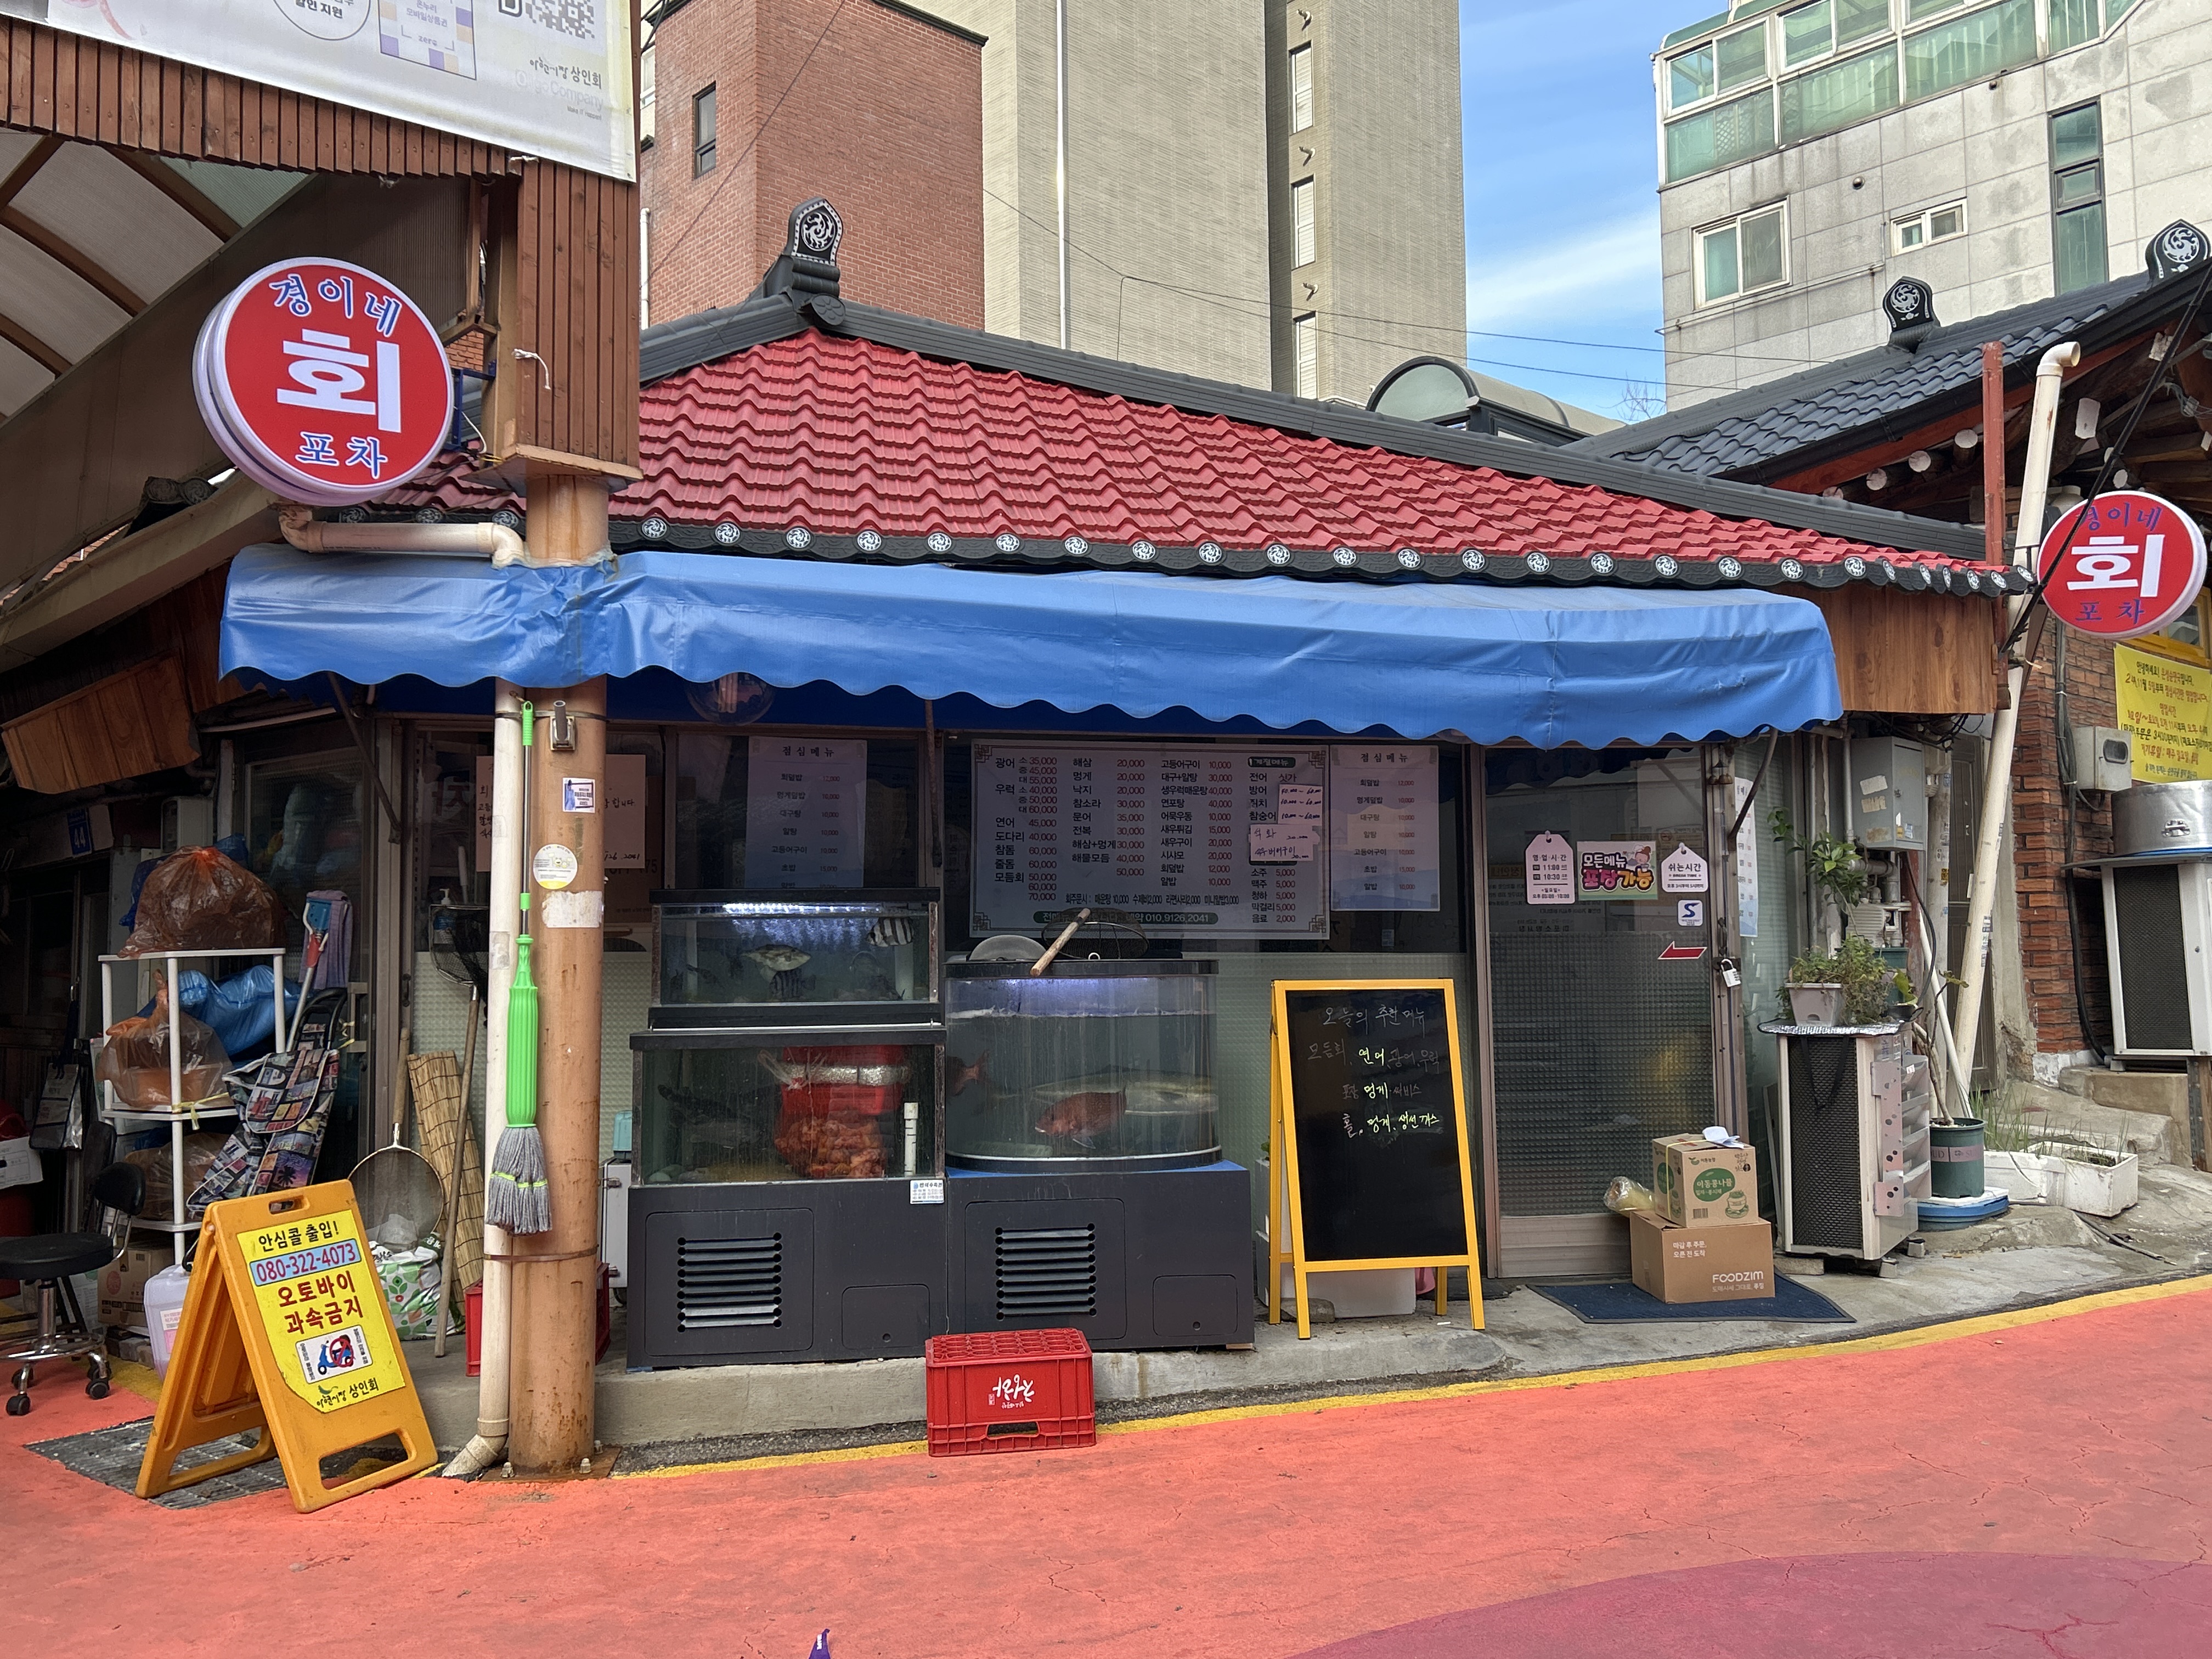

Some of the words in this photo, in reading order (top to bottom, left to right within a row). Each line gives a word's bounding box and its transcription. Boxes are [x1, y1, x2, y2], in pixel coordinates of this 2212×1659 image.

[320, 3, 343, 19] 지원
[417, 0, 437, 13] 온누리
[407, 8, 448, 27] 모바일상품권
[418, 35, 437, 46] zero
[571, 66, 601, 89] 상인회
[269, 274, 402, 337] 경이네
[276, 328, 402, 433] 회
[295, 431, 388, 478] 포차
[2076, 502, 2162, 531] 경이네
[2067, 534, 2165, 598] 회
[2075, 599, 2145, 625] 포차
[995, 758, 1015, 768] 광어
[1029, 757, 1057, 766] 35,000
[1073, 758, 1092, 767] 해삼
[1117, 759, 1146, 768] 20,000
[1161, 760, 1200, 769] 고등어구이
[1209, 761, 1232, 769] 10,000
[1029, 767, 1057, 775] 45,000
[1029, 777, 1057, 785] 55,000
[1073, 771, 1092, 781] 멍게
[1117, 772, 1146, 782] 20,000
[1161, 772, 1197, 782] 대구+알탕
[1209, 774, 1232, 782] 30,000
[1249, 773, 1267, 782] 전어
[1279, 774, 1297, 782] 싯가
[995, 784, 1015, 794] 우럭
[1029, 787, 1057, 795] 40,000
[1073, 785, 1092, 794] 낙지
[1117, 786, 1146, 795] 20,000
[1161, 785, 1207, 795] 생우럭매운탕
[1209, 787, 1232, 795] 40,000
[1249, 786, 1267, 795] 방어
[1029, 796, 1057, 805] 50,000
[1073, 799, 1101, 808] 참소라
[1117, 800, 1145, 809] 30,000
[1161, 798, 1185, 808] 연포탕
[1209, 799, 1232, 808] 40,000
[1029, 806, 1057, 815] 60,000
[1073, 812, 1091, 822] 문어
[1116, 814, 1144, 822] 35,000
[1161, 812, 1192, 822] 어묵우동
[1209, 812, 1231, 821] 10,000
[1249, 812, 1277, 821] 참숭어
[996, 817, 1015, 828] 연어
[1029, 819, 1057, 828] 45,000
[1073, 826, 1092, 836] 전복
[1116, 827, 1144, 836] 30,000
[1161, 825, 1193, 834] 새우튀김
[1209, 826, 1231, 834] 15,000
[74, 826, 86, 848] 44
[995, 831, 1025, 842] 도다리
[1029, 833, 1057, 842] 40,000
[1363, 831, 1376, 839] 알탕
[1072, 839, 1116, 849] 해삼+멍게
[1116, 841, 1144, 850] 30,000
[1161, 838, 1192, 848] 새우구이
[1208, 839, 1232, 848] 20,000
[771, 846, 808, 854] 고등어구이
[995, 844, 1015, 855] 참돔
[1029, 847, 1057, 855] 60,000
[1071, 853, 1110, 863] 해물모듬
[1116, 854, 1144, 863] 40,000
[1161, 851, 1184, 860] 시샤모
[1208, 852, 1232, 861] 20,000
[1583, 852, 1627, 869] 모든메뉴
[995, 859, 1015, 870] 줄돔
[1029, 860, 1057, 869] 60,000
[1161, 864, 1184, 873] 회덮밥
[1208, 865, 1231, 873] 12,000
[1668, 863, 1701, 872] 쉬는시간
[995, 872, 1024, 883] 모듬회
[1029, 873, 1057, 882] 50,000
[1116, 868, 1144, 877] 50,000
[1251, 868, 1267, 877] 소주
[1276, 868, 1295, 877] 5,000
[1028, 883, 1057, 891] 60,000
[1161, 877, 1177, 887] 알밥
[1208, 878, 1231, 887] 10,000
[1251, 879, 1267, 888] 맥주
[1276, 880, 1295, 888] 5,000
[1029, 893, 1056, 901] 70,000
[1113, 894, 1129, 905] 10,000
[1251, 891, 1267, 900] 청하
[1276, 891, 1295, 900] 5,000
[1251, 902, 1275, 912] 막걸리
[1276, 903, 1295, 912] 5,000
[1145, 913, 1209, 923] 010.9126.2041
[1252, 914, 1268, 923] 음료
[1276, 915, 1295, 923] 2,000
[1323, 1007, 1368, 1035] 오늘의
[1402, 1007, 1426, 1038] 메뉴
[258, 1228, 302, 1252] 안심콜
[305, 1221, 339, 1242] 출입!
[257, 1243, 356, 1283] 080-322-4073
[1712, 1271, 1764, 1283] FOODZIM
[278, 1270, 356, 1308] 오토바이
[284, 1296, 364, 1335] 과속금지
[317, 1388, 346, 1408] 아현시장
[348, 1378, 379, 1398] 상인회
[992, 1374, 1035, 1403] 청하
